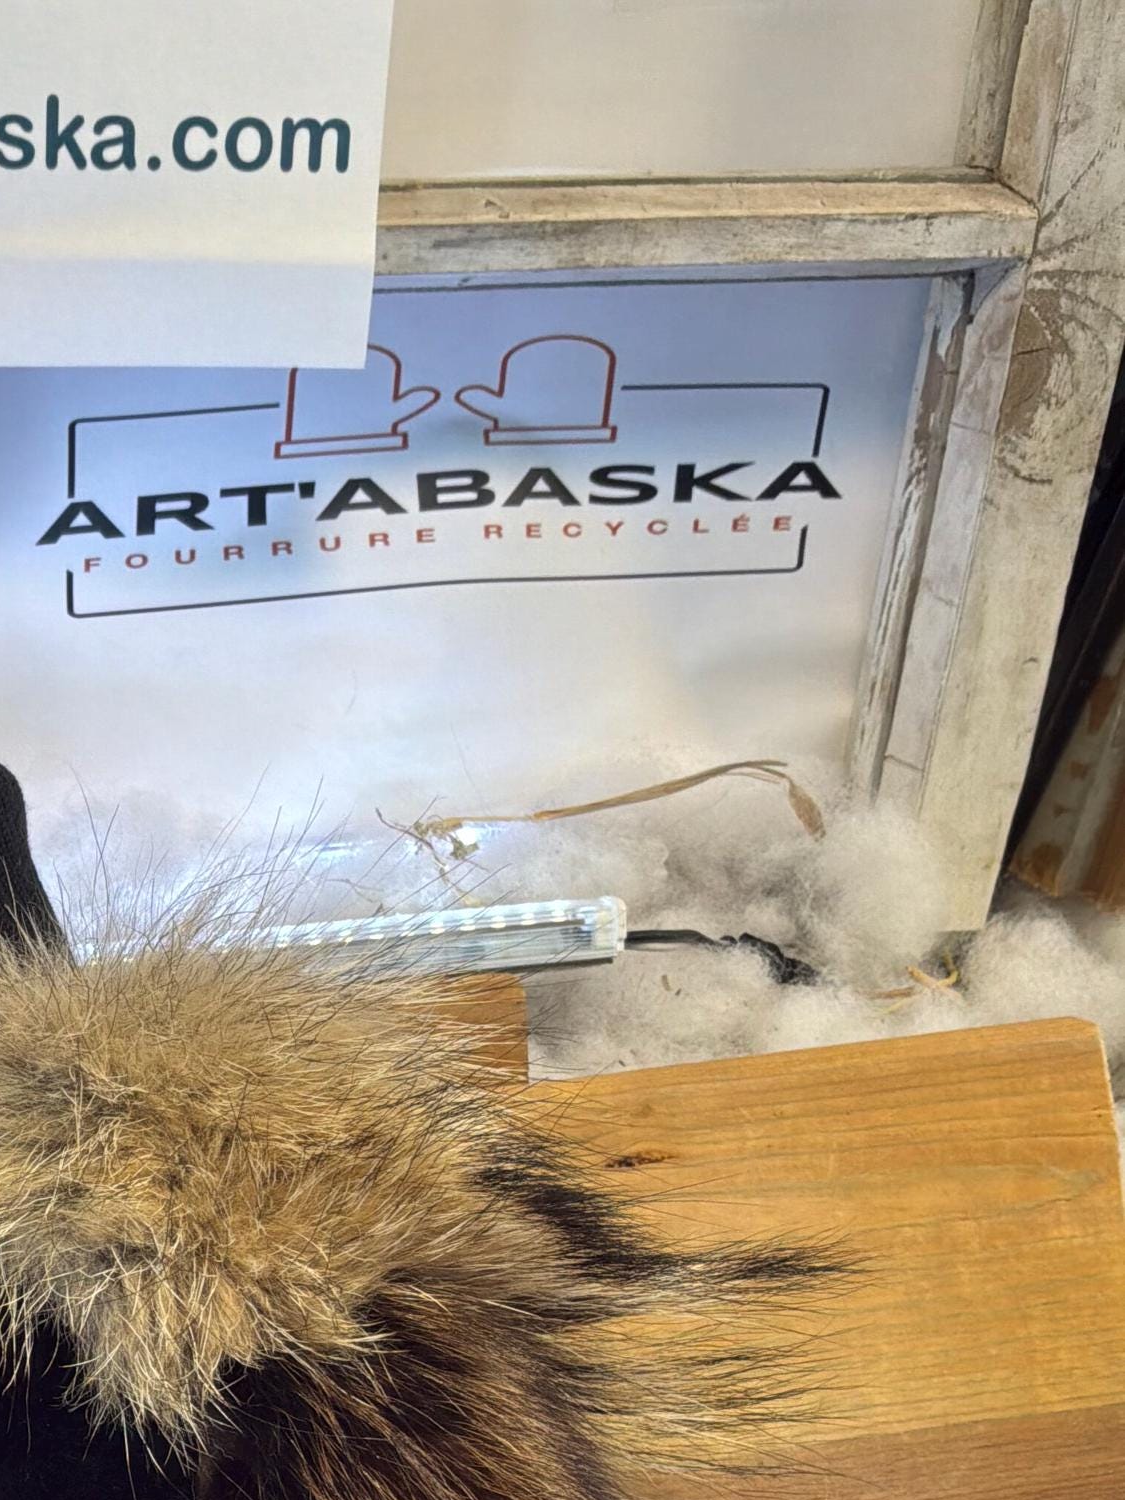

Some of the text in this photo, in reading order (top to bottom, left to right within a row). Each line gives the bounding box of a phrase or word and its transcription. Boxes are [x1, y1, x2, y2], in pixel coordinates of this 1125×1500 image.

[37, 459, 842, 546] ART'ABASKA
[83, 513, 792, 573] FOURRURE RECYCLÉE
